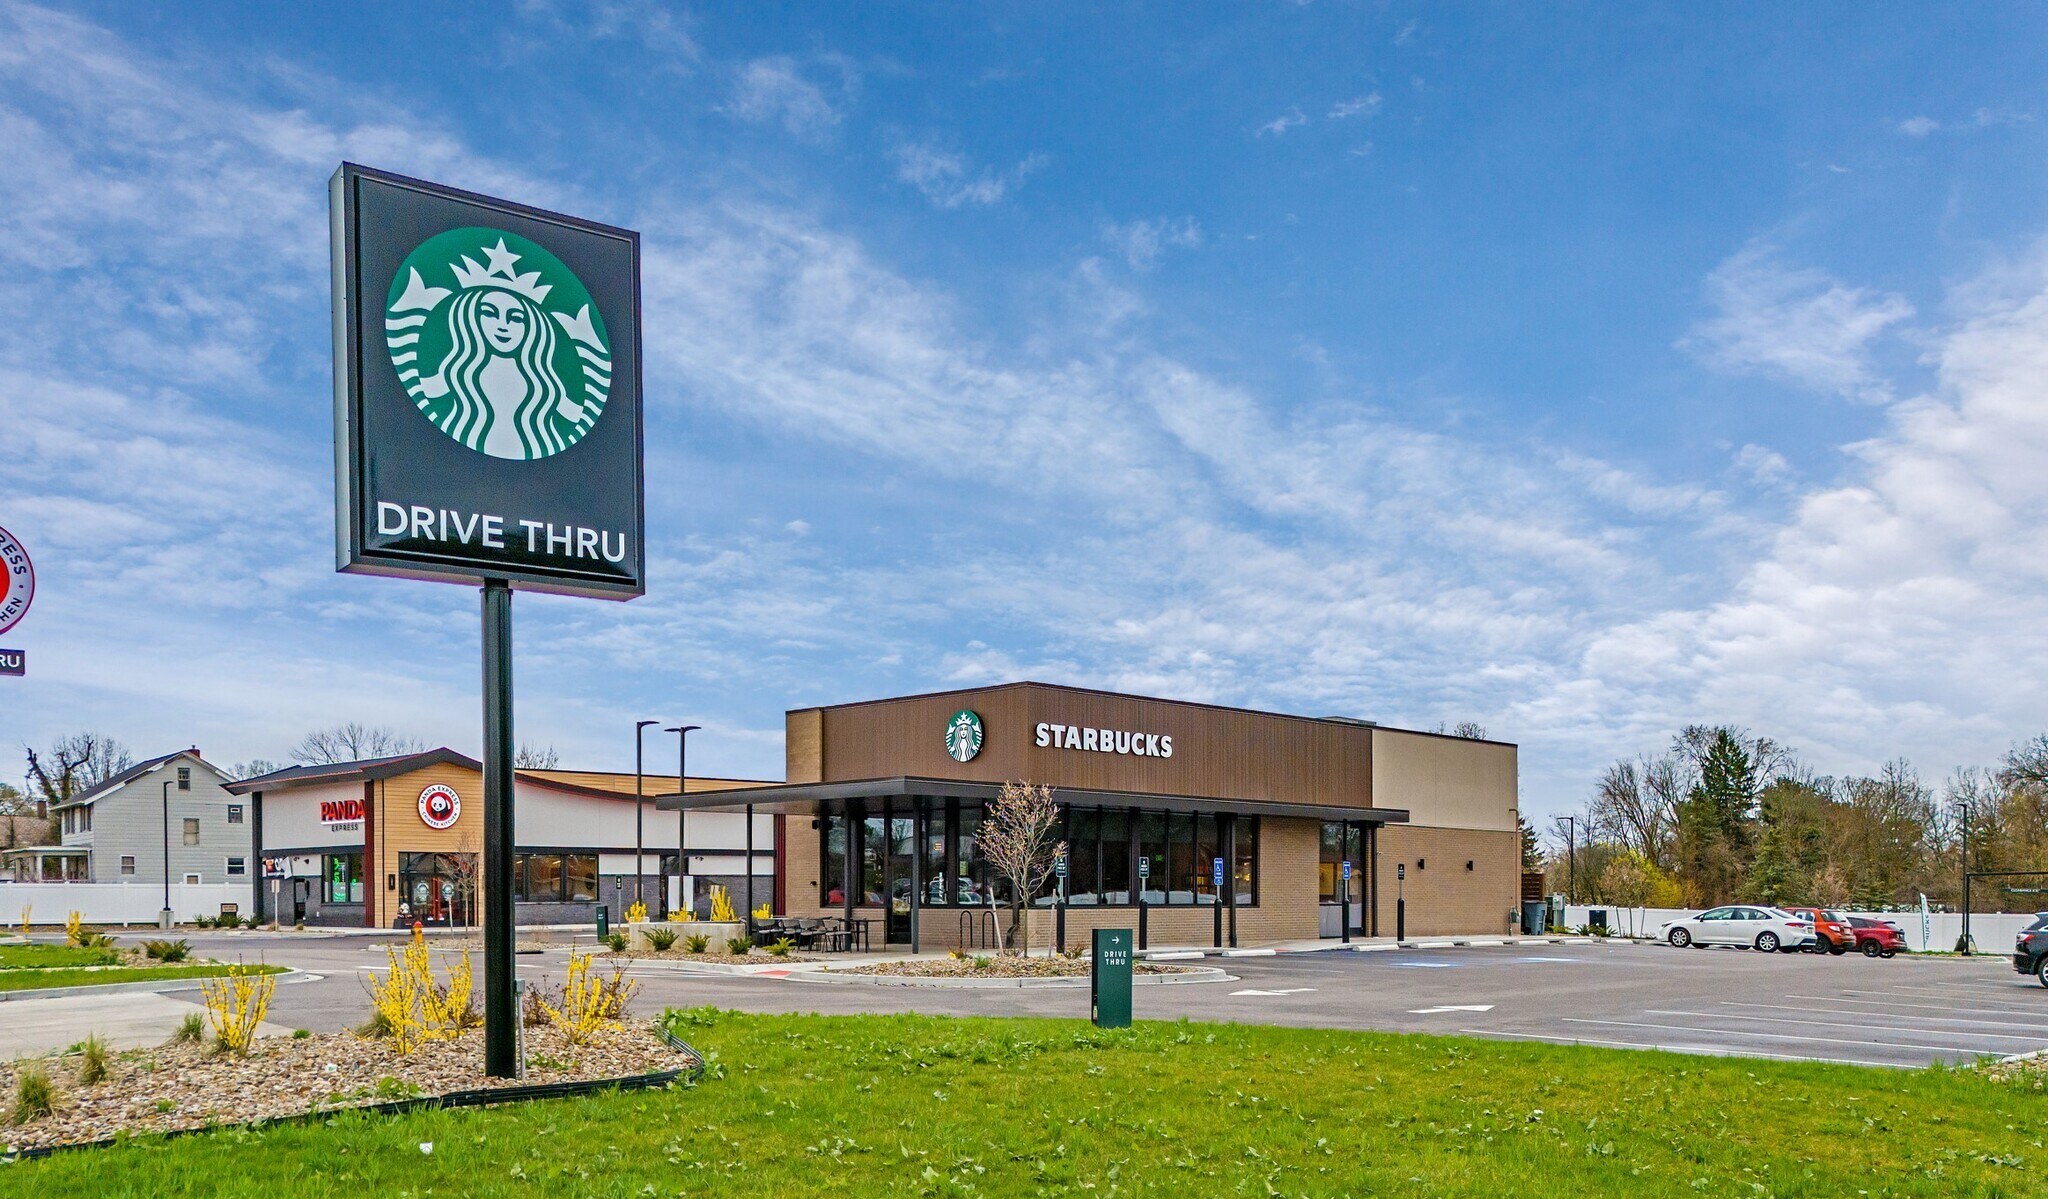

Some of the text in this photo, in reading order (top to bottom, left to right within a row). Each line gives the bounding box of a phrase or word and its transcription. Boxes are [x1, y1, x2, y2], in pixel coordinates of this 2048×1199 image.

[377, 501, 626, 563] DRIVE THRU
[1035, 722, 1173, 758] STARBUCKS
[420, 786, 459, 805] PANDA EXPRESS
[320, 799, 365, 821] PANDA
[331, 823, 359, 832] EXPRESS
[1104, 950, 1127, 958] DRIVE
[1105, 958, 1126, 966] THRU
